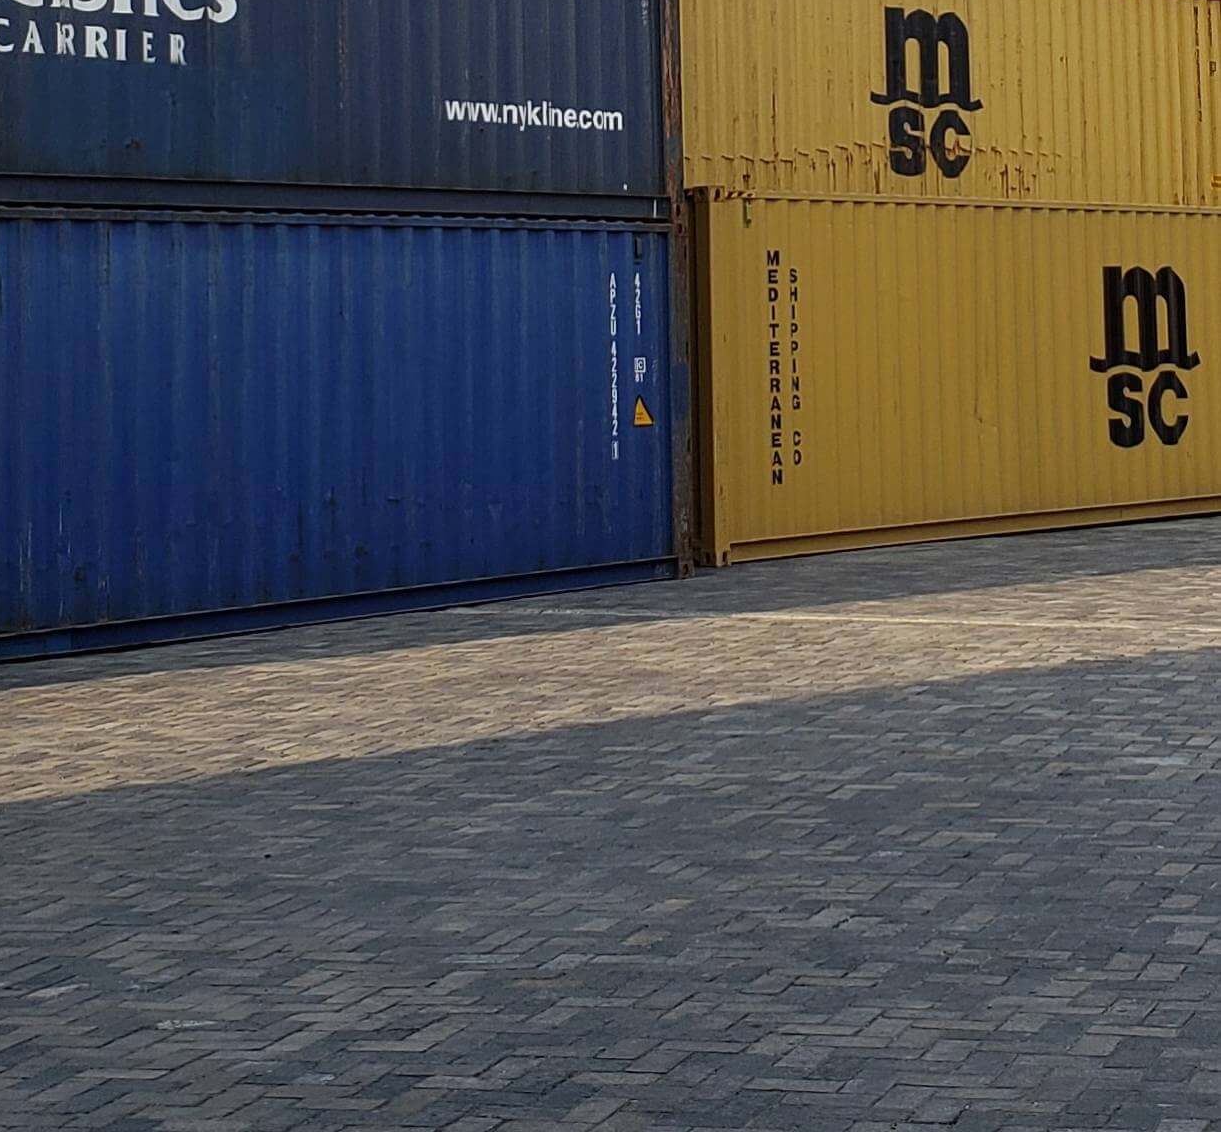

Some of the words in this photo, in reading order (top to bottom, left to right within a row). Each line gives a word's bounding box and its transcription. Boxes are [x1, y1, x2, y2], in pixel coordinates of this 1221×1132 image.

[611, 341, 619, 436] 422942
[767, 249, 783, 485] MEDITERRANEAN
[790, 268, 801, 410] SHIPPING
[793, 431, 802, 465] CO
